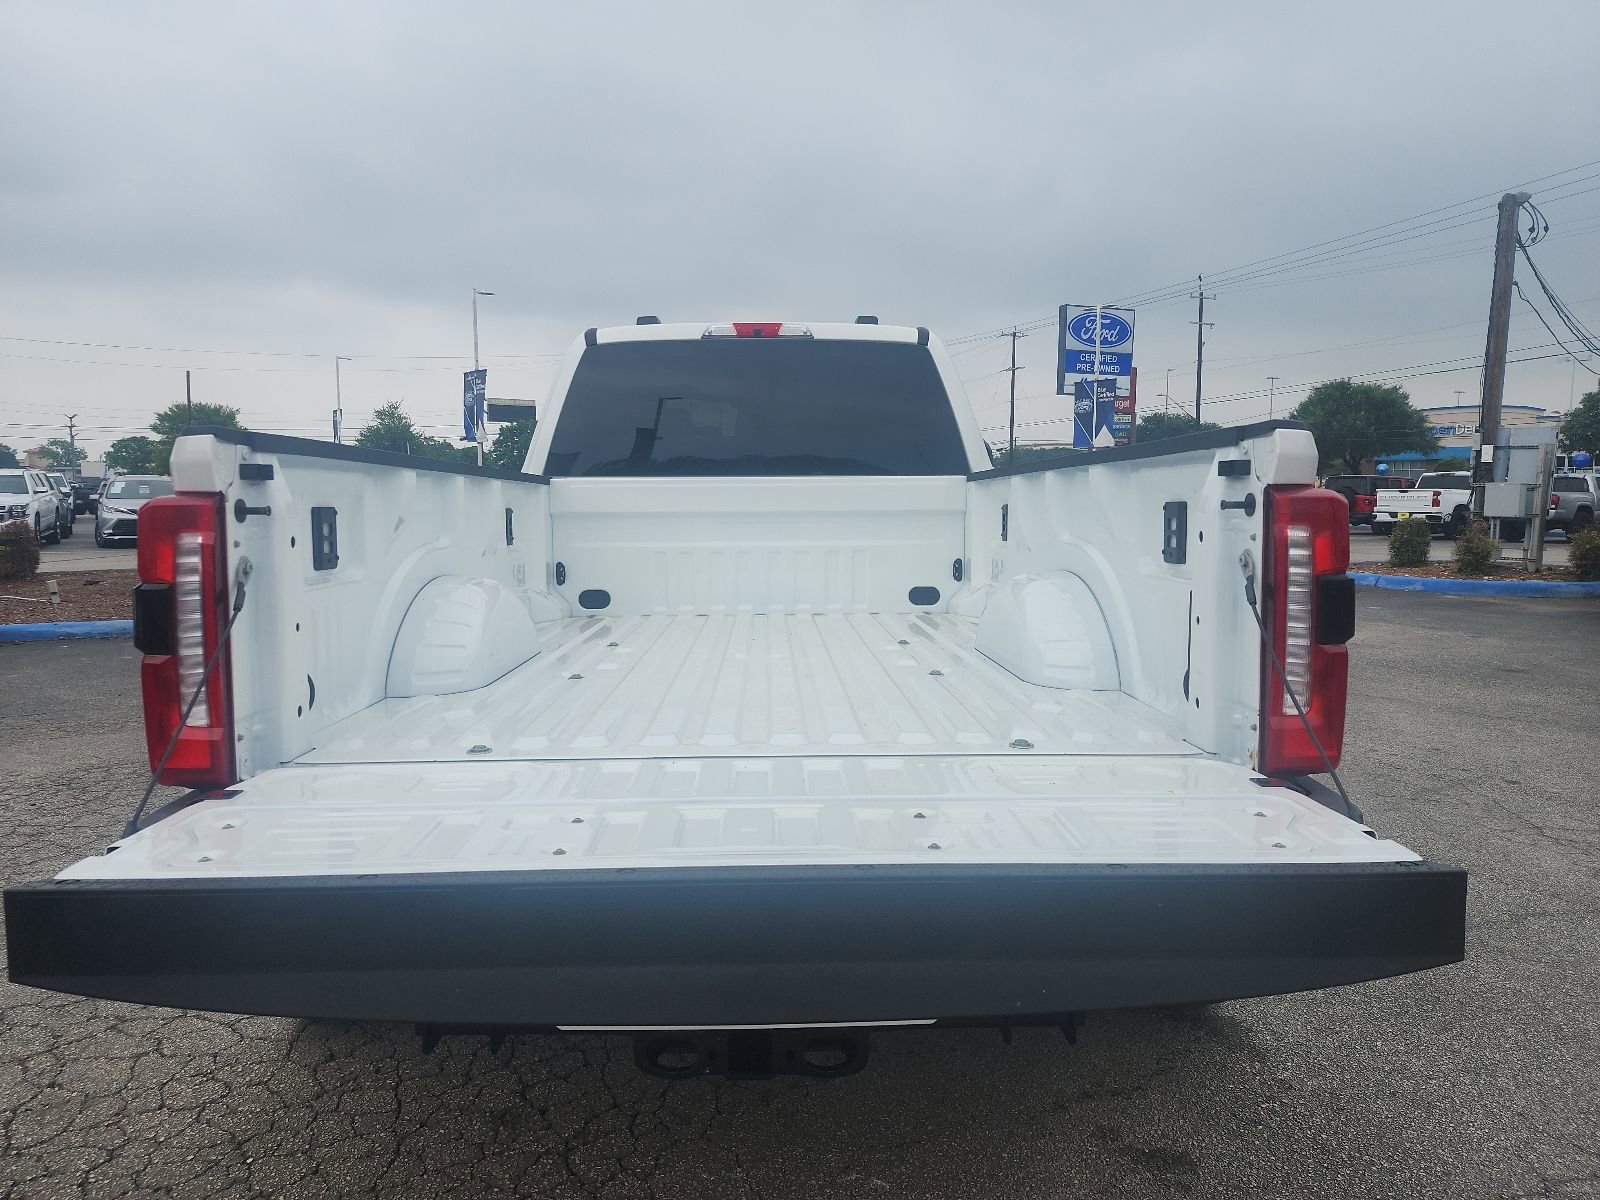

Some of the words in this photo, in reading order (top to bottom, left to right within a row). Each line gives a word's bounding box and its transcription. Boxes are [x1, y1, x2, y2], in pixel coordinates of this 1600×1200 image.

[1080, 353, 1118, 363] CERIFIED
[1076, 363, 1121, 373] PRE-WNED
[1114, 400, 1130, 409] rget
